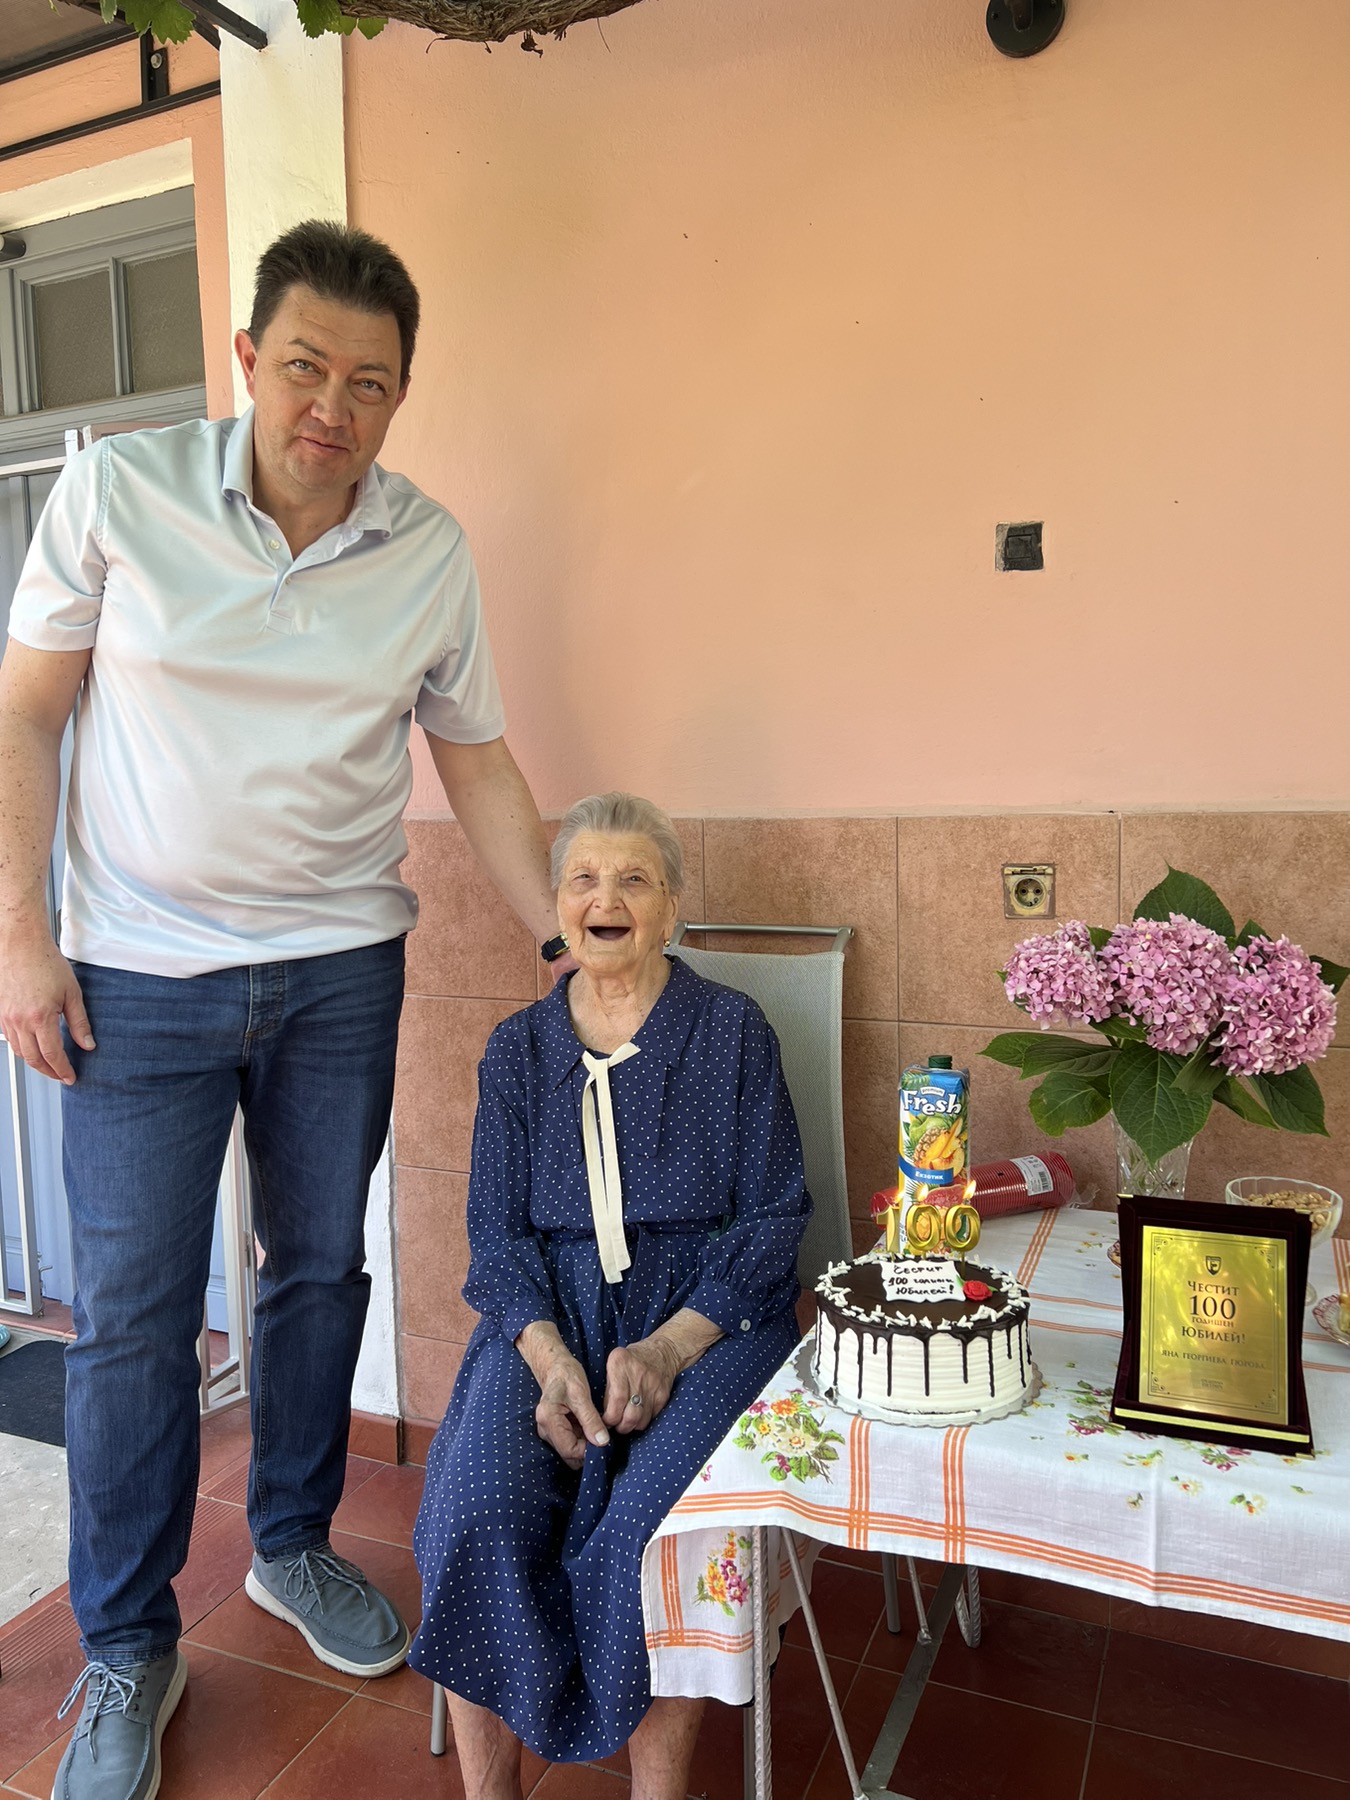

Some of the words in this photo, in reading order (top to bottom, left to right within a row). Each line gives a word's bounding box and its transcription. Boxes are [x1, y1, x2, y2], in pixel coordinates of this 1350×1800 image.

[902, 1089, 962, 1116] Fresh
[876, 1204, 981, 1252] 100
[888, 1277, 908, 1286] 100
[1187, 1280, 1240, 1296] ЧЕСТИТ
[1190, 1295, 1236, 1320] 100
[1192, 1316, 1234, 1327] ГОДИШЕН
[1181, 1326, 1246, 1344] ЮБИЛЕЙ!
[1161, 1349, 1179, 1358] ЯНА
[1182, 1352, 1227, 1364] ГЕОРГИЕВА
